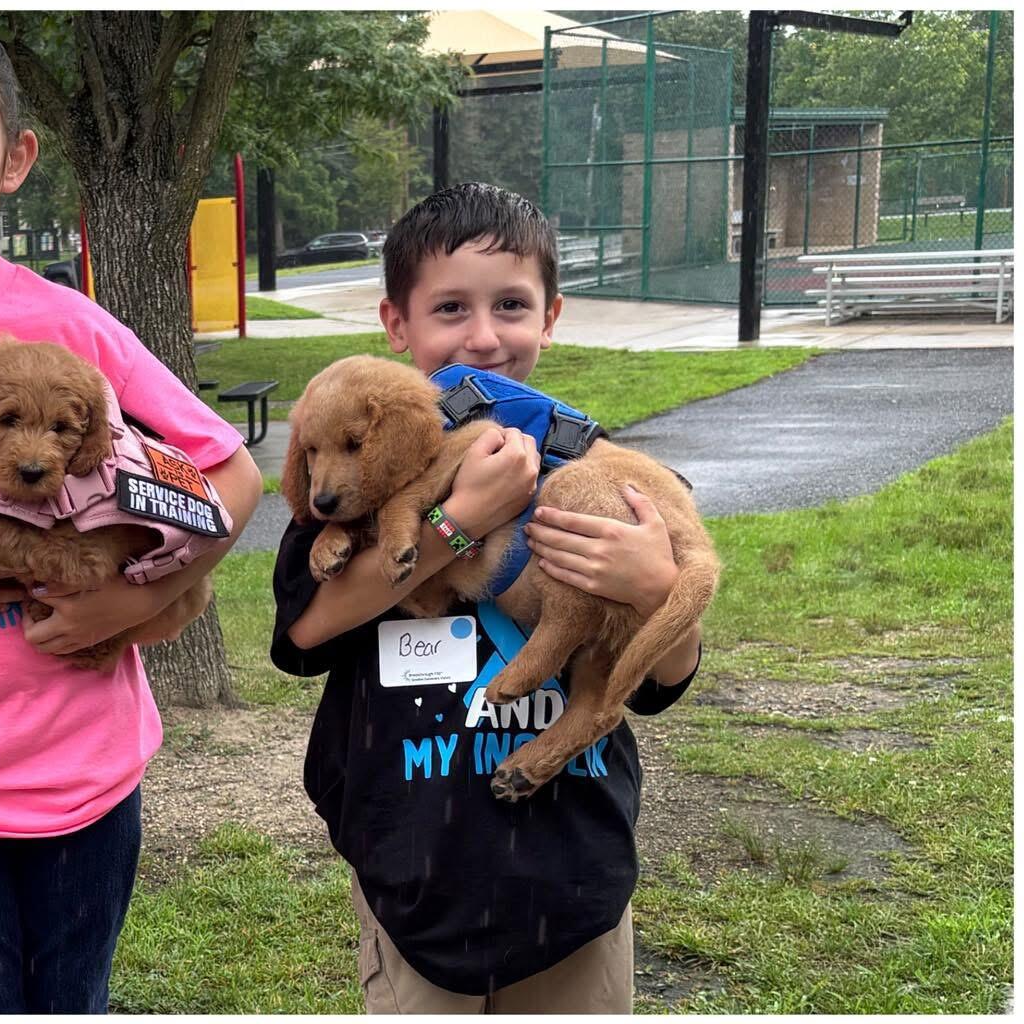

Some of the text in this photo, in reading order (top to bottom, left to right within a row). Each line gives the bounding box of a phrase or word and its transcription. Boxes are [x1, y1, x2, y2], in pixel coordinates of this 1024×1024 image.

[128, 477, 214, 520] SERVICE DOG
[130, 493, 218, 533] IN TRAINING
[399, 633, 442, 657] Bear
[465, 687, 565, 730] AND
[402, 733, 458, 781] MY
